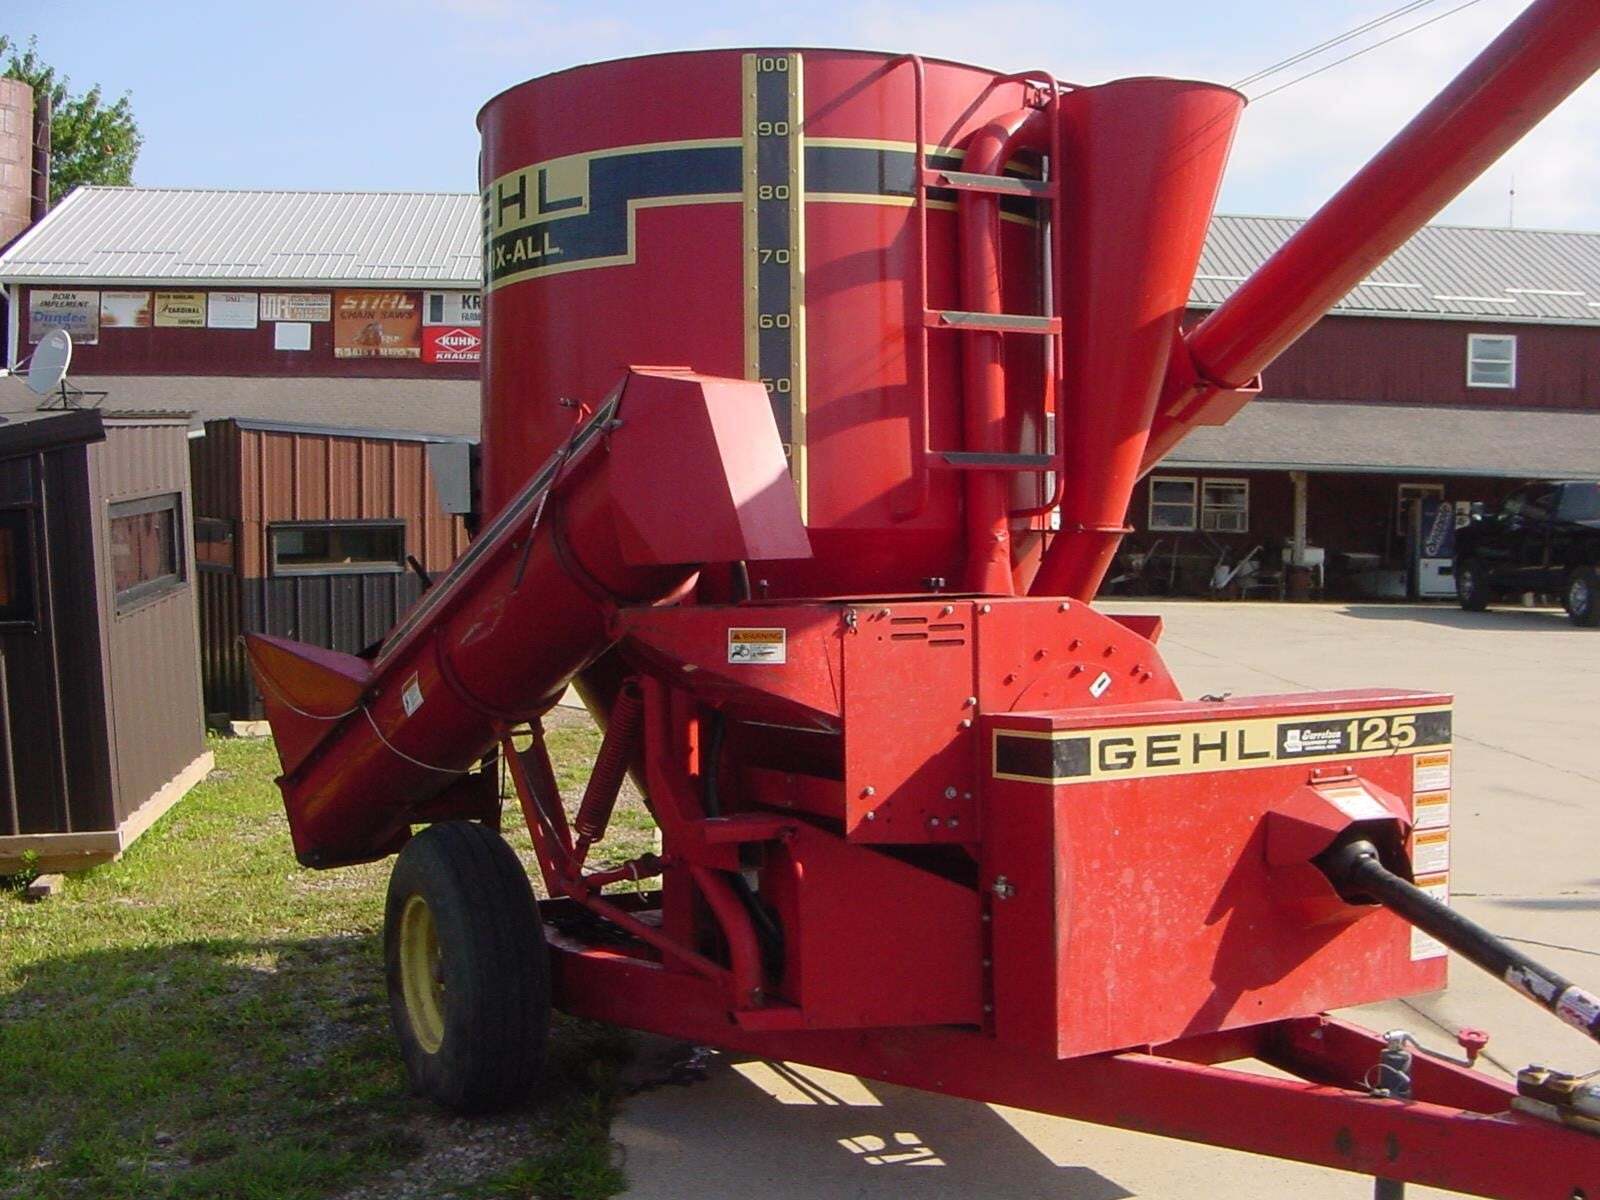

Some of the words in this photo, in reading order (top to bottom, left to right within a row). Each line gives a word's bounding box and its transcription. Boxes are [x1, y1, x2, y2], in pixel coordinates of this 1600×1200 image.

[757, 57, 788, 72] 100
[758, 121, 788, 136] 90
[758, 185, 789, 200] 80
[759, 249, 790, 264] 70
[40, 300, 89, 308] IMPLEMENT
[341, 294, 415, 310] STIHL
[340, 310, 376, 320] CHAIN
[383, 309, 415, 319] SAWS
[759, 313, 790, 328] 60
[442, 335, 476, 346] KUHN
[436, 352, 480, 360] KRAUSE
[1098, 729, 1271, 771] GEHL
[1346, 715, 1416, 752] 125
